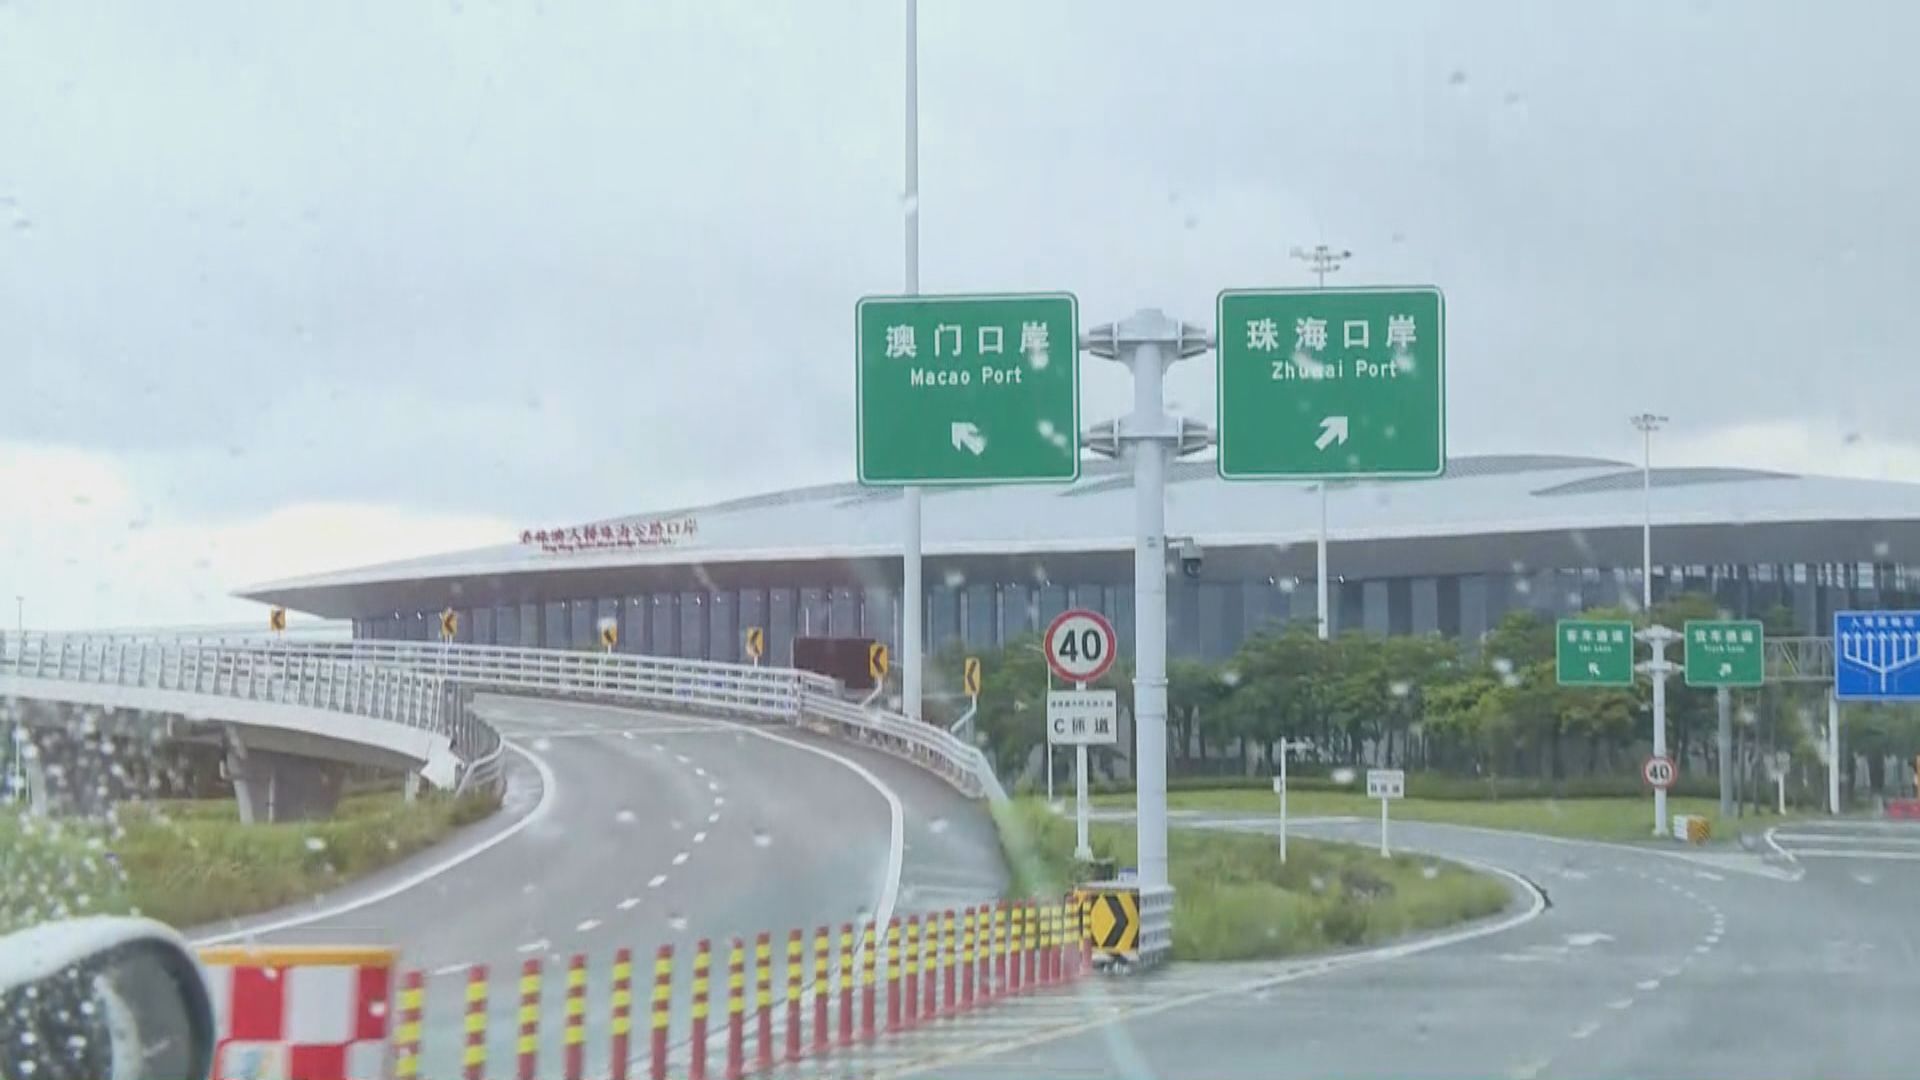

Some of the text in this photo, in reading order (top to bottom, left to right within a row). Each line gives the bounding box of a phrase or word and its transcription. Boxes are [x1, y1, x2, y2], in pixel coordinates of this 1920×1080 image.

[885, 320, 1050, 358] 澳门口岸
[1246, 313, 1417, 352] 珠海口岸
[910, 365, 1022, 387] Macao Port
[1271, 359, 1397, 380] Zhuai Port
[1059, 628, 1102, 663] 40
[1649, 764, 1669, 780] 40
